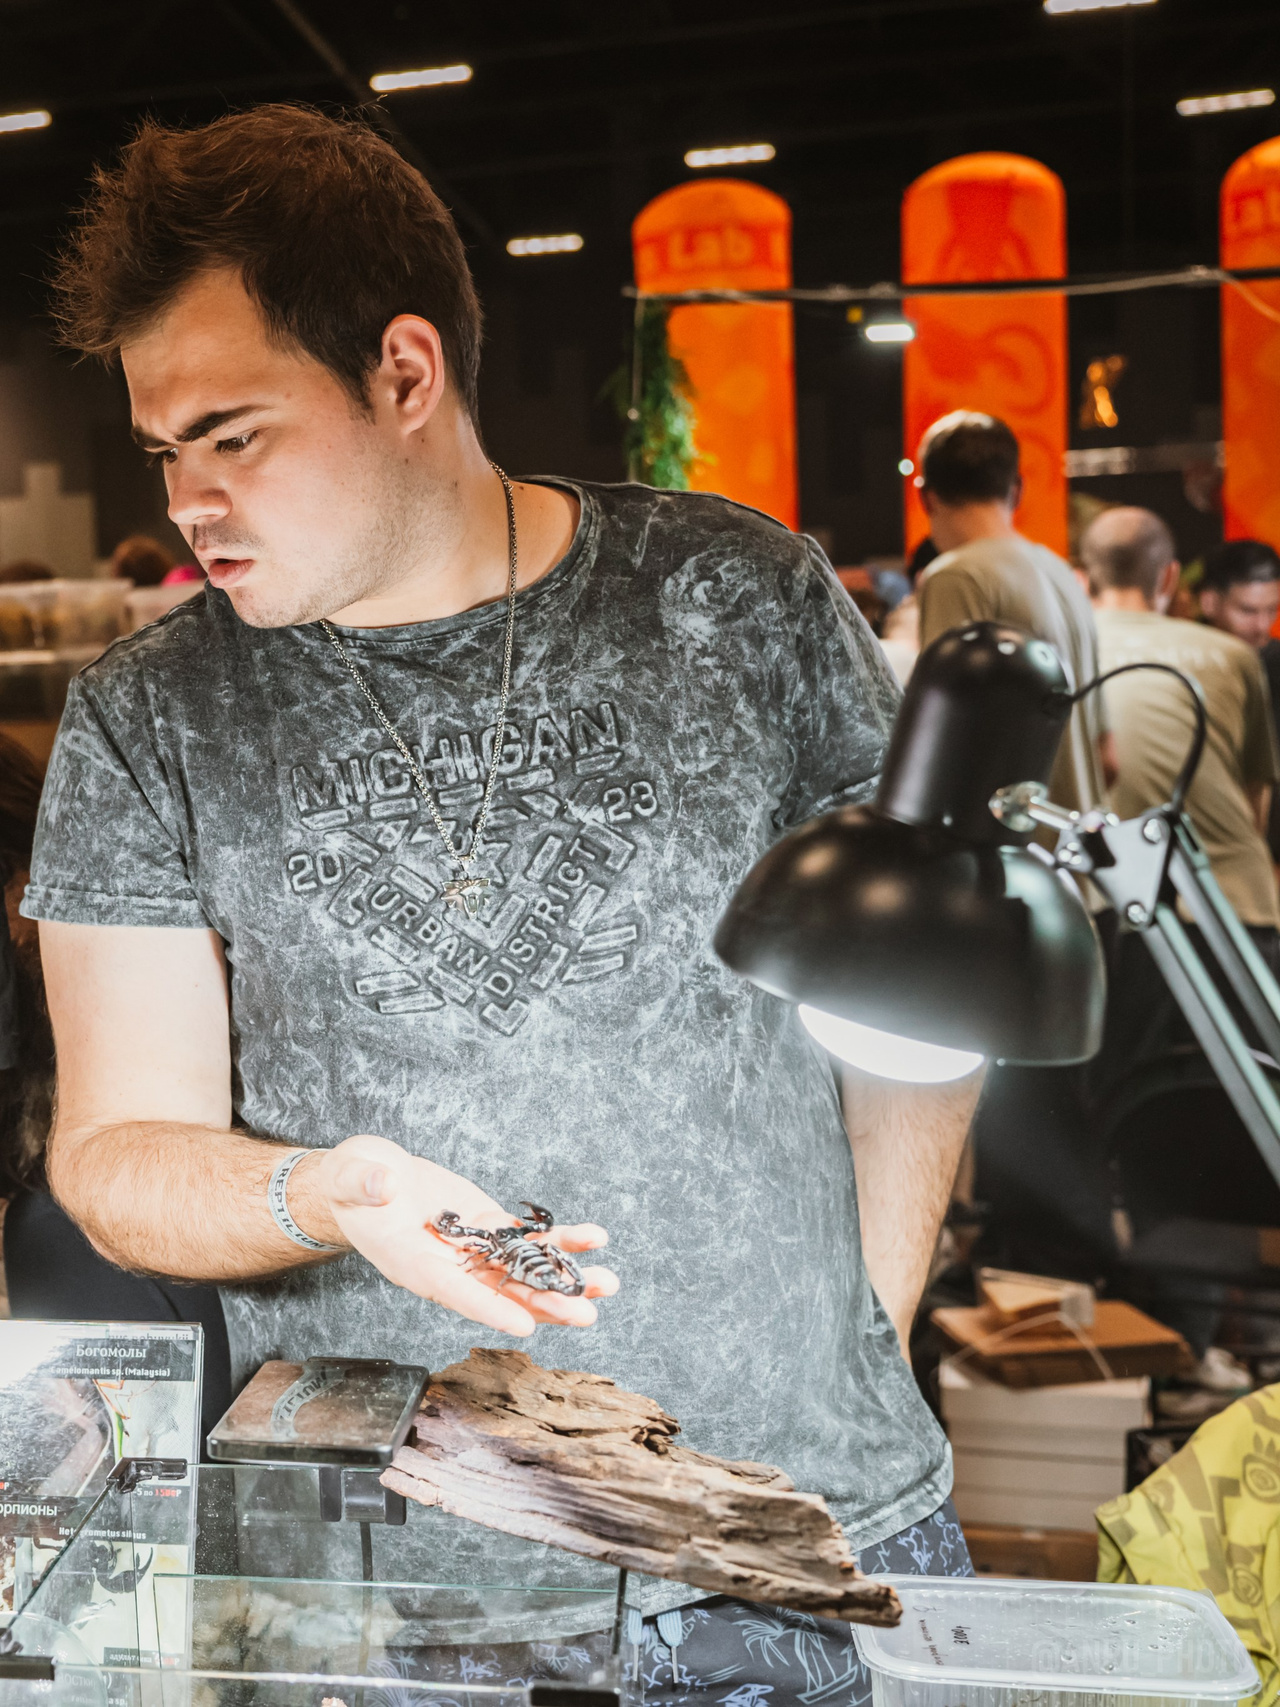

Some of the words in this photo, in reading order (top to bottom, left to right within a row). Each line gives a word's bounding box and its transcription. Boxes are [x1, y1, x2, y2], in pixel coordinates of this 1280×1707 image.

[290, 701, 620, 812] MICHIGAN
[603, 780, 658, 823] 23
[286, 849, 344, 893] 20
[370, 884, 490, 977] URBAN
[483, 838, 598, 998] DISTRICT
[76, 1344, 147, 1358] Богомолы
[125, 1367, 171, 1379] (Malaysia)
